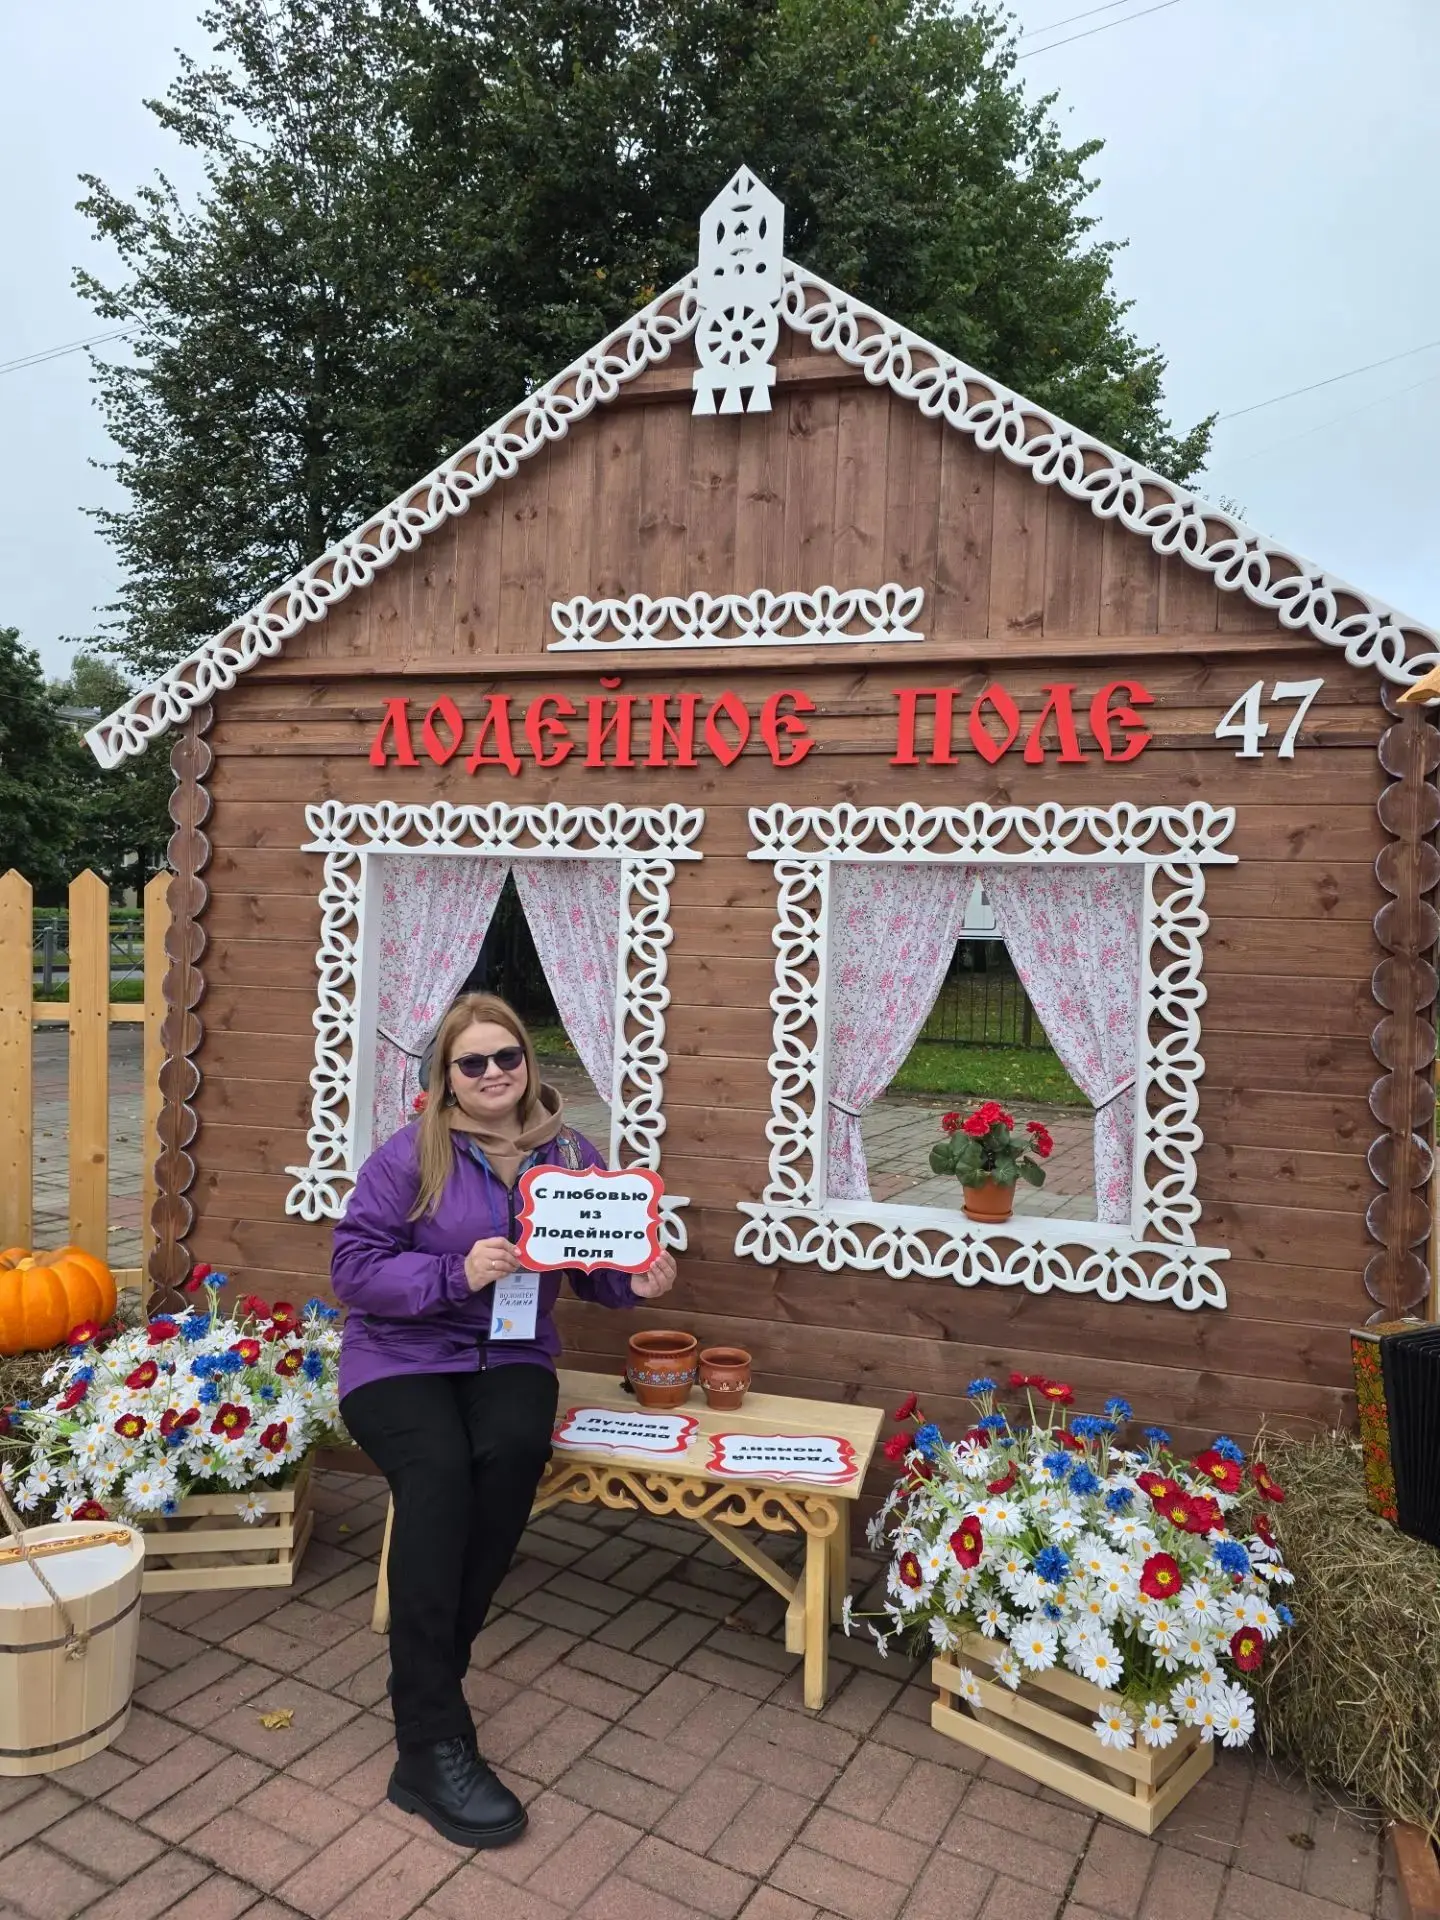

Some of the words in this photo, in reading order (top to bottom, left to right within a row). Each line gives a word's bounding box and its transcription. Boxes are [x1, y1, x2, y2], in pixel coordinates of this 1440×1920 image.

[1213, 678, 1326, 760] 47
[369, 677, 816, 776] ЛОДЕЙНОЕ
[889, 680, 1156, 766] ПОЛЕ
[535, 1187, 548, 1199] С
[552, 1188, 648, 1201] любовью
[579, 1210, 602, 1219] из
[533, 1226, 645, 1240] Лодейного
[563, 1246, 614, 1259] Поля
[586, 1418, 670, 1430] Лучшая
[576, 1426, 671, 1439] команда
[731, 1455, 834, 1463] Удачный
